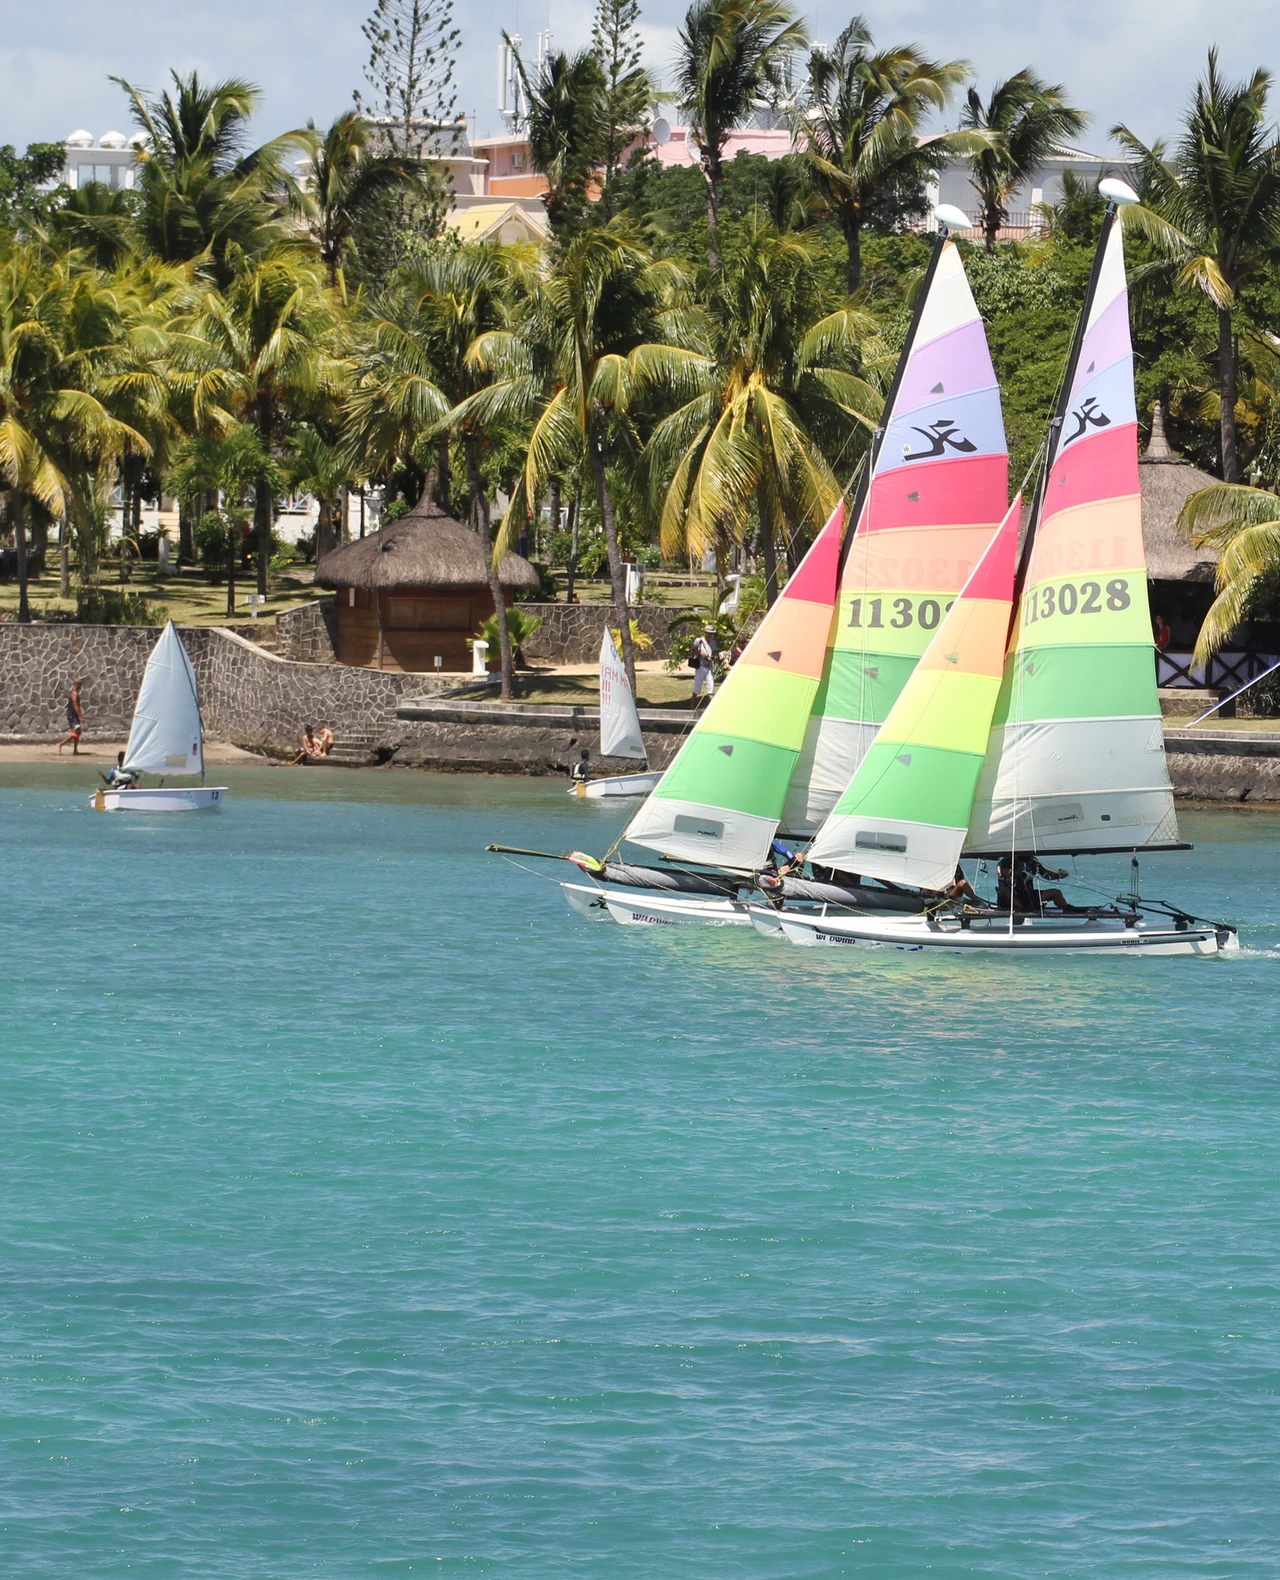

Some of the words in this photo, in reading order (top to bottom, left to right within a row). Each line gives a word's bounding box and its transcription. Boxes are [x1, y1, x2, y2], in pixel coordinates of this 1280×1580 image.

[847, 598, 955, 630] 1130
[1024, 579, 1131, 627] 113028
[211, 791, 219, 800] 13
[815, 933, 856, 945] WIDWIND
